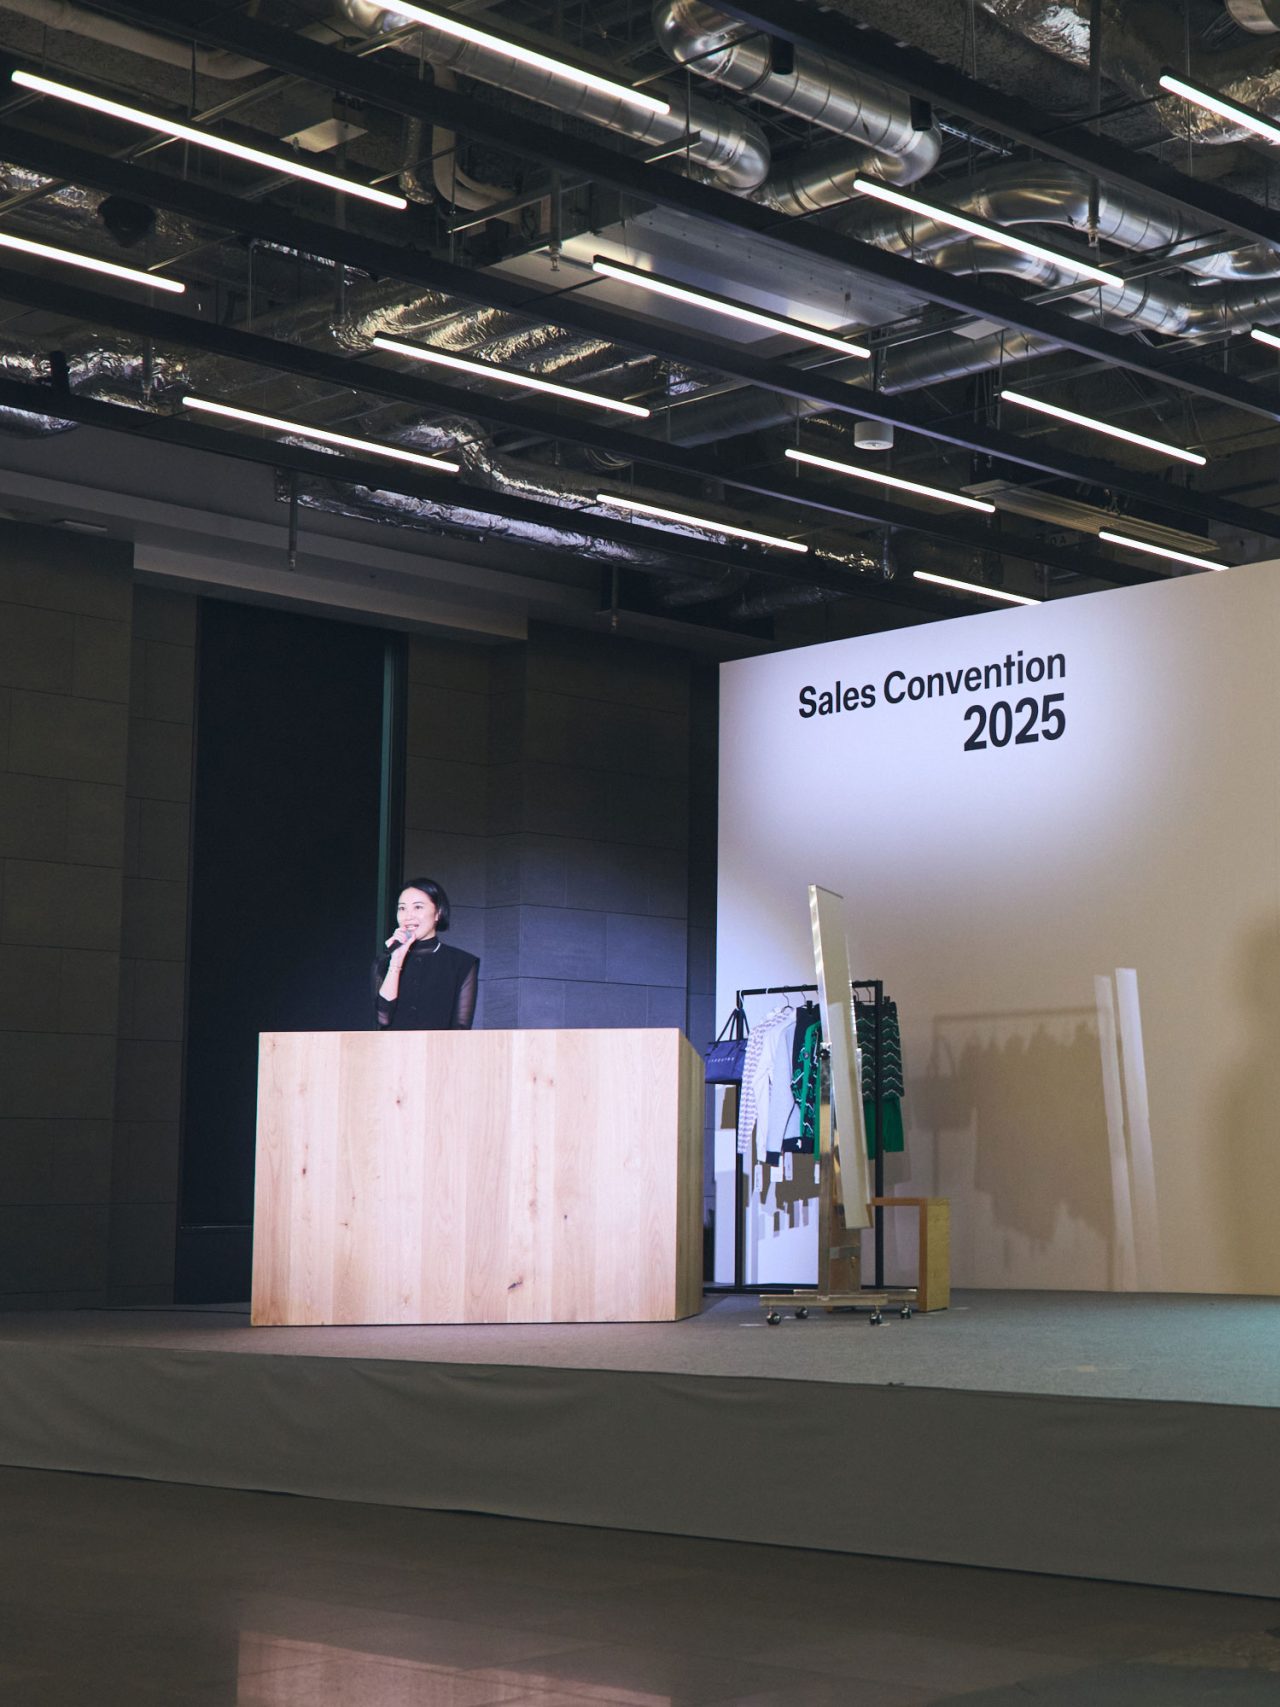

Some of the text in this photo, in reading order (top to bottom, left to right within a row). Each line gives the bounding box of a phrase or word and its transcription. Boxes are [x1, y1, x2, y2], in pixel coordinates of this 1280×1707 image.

[799, 650, 1066, 718] Sales Convention
[963, 692, 1067, 751] 2025
